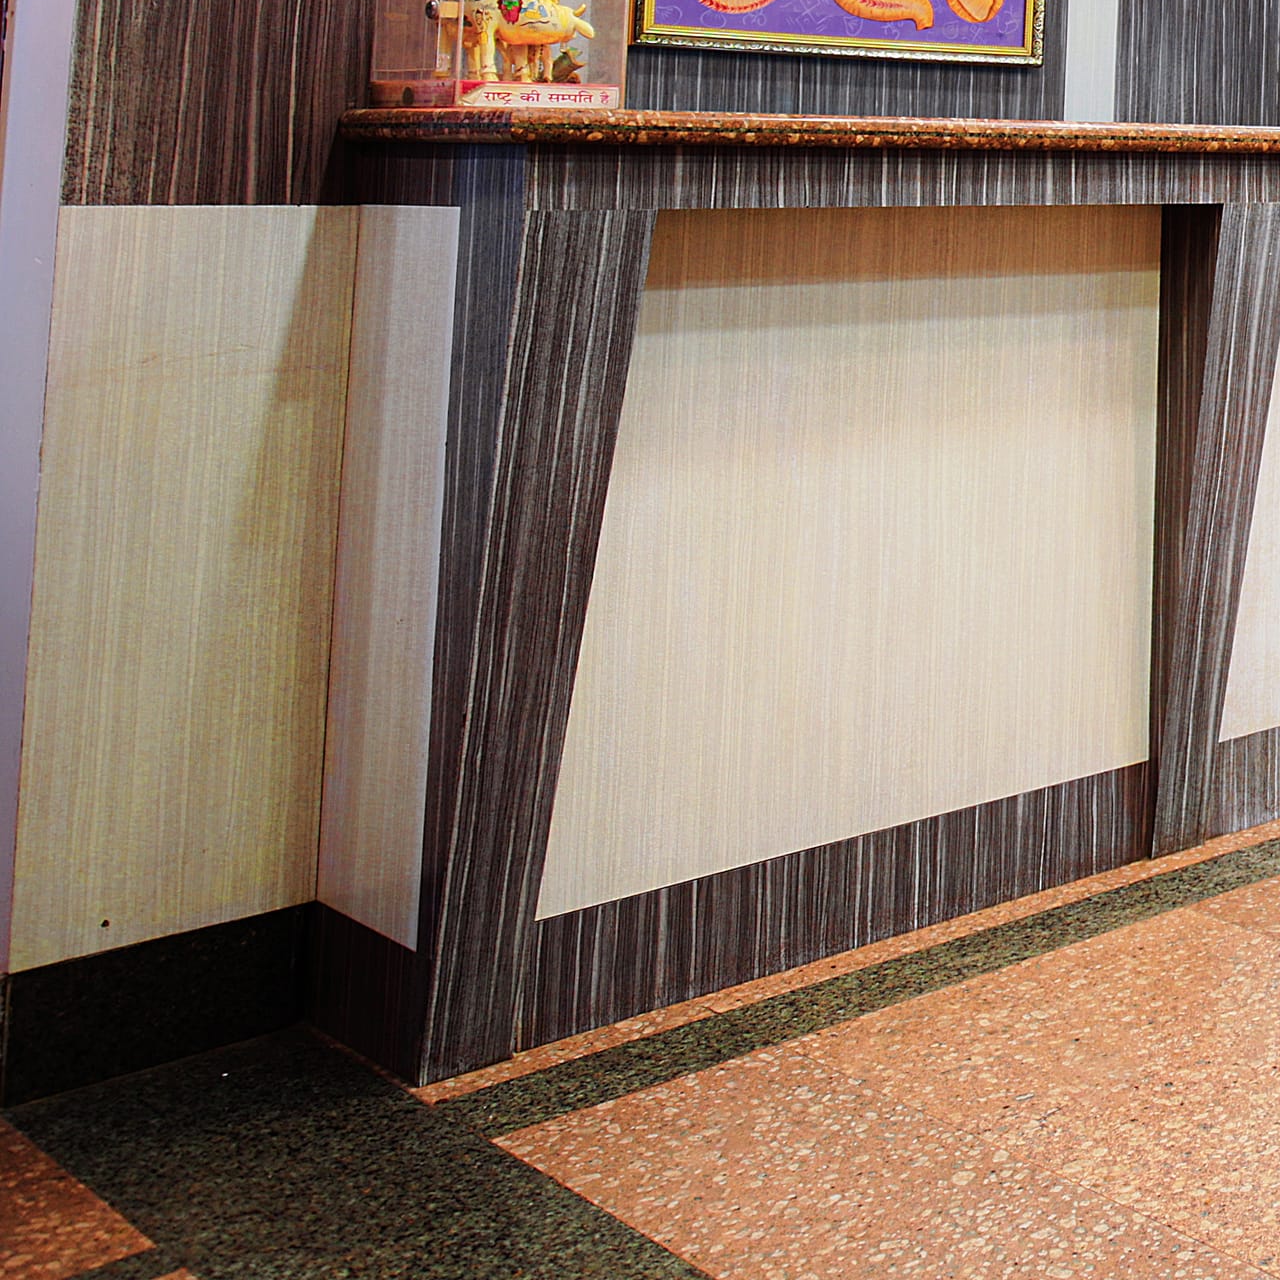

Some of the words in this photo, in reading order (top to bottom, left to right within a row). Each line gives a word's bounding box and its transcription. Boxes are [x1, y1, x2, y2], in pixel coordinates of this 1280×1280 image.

[483, 91, 512, 105] राष्ट्र
[519, 89, 541, 103] की
[547, 90, 594, 104] सम्पति
[600, 91, 610, 105] है
